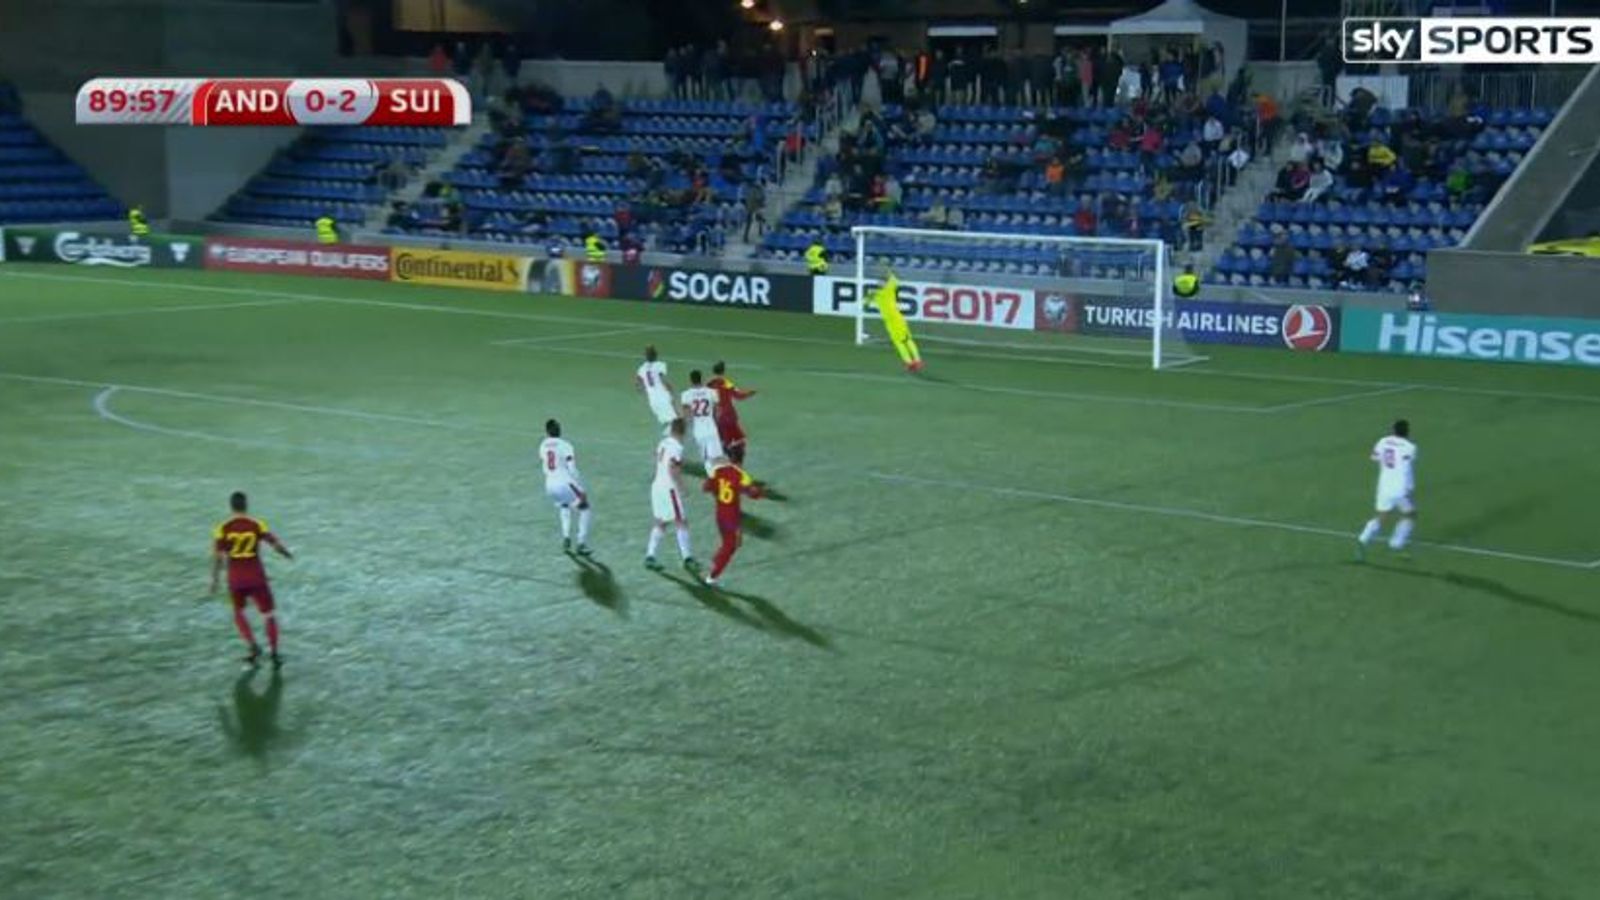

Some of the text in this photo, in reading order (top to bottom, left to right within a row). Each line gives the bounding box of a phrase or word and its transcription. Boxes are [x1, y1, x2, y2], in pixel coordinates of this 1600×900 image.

[227, 247, 306, 265] EUROPEAN
[396, 252, 504, 282] Continental
[668, 271, 771, 306] SOCAR
[922, 286, 1021, 324] 2017
[1084, 305, 1279, 335] TURKISH AIRLINES
[1378, 312, 1600, 363] Hisense
[692, 399, 710, 417] 22
[718, 478, 734, 504] 16
[226, 531, 258, 558] 22
